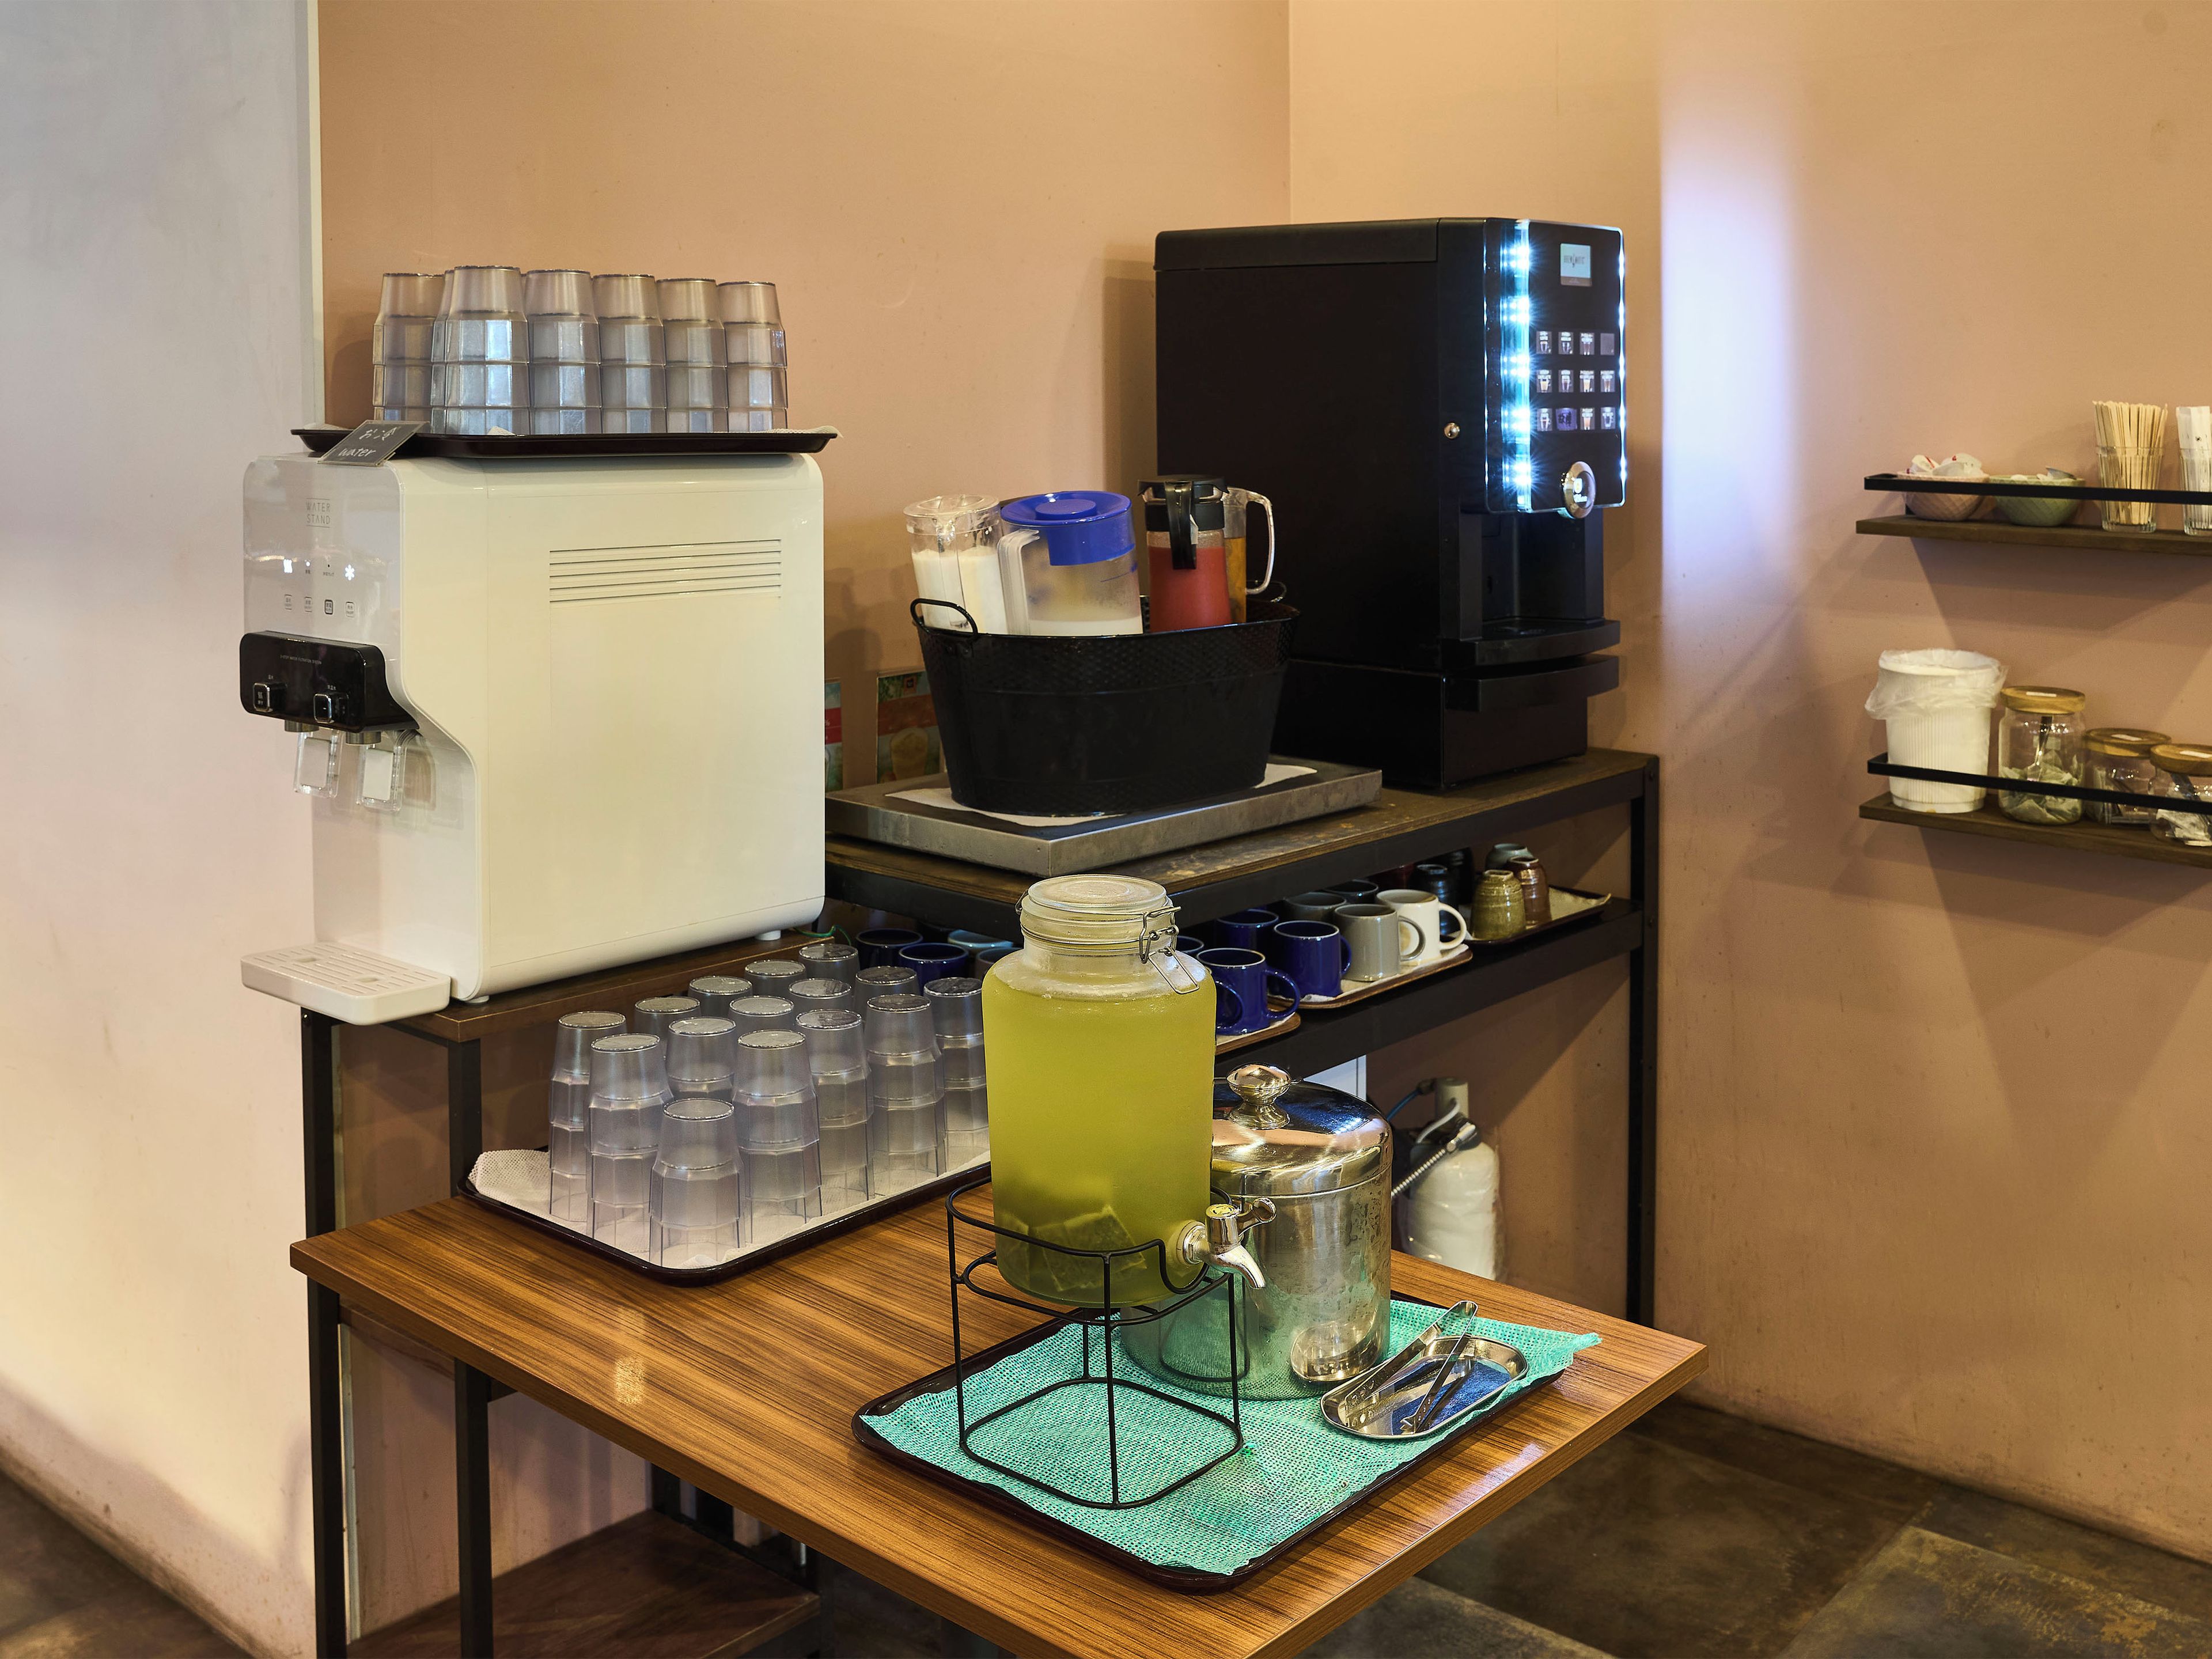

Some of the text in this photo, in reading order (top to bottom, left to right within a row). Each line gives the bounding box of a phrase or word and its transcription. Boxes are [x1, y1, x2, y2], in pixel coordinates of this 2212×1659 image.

[338, 447, 377, 457] water
[305, 502, 331, 512] WATER
[306, 513, 331, 525] STAND
